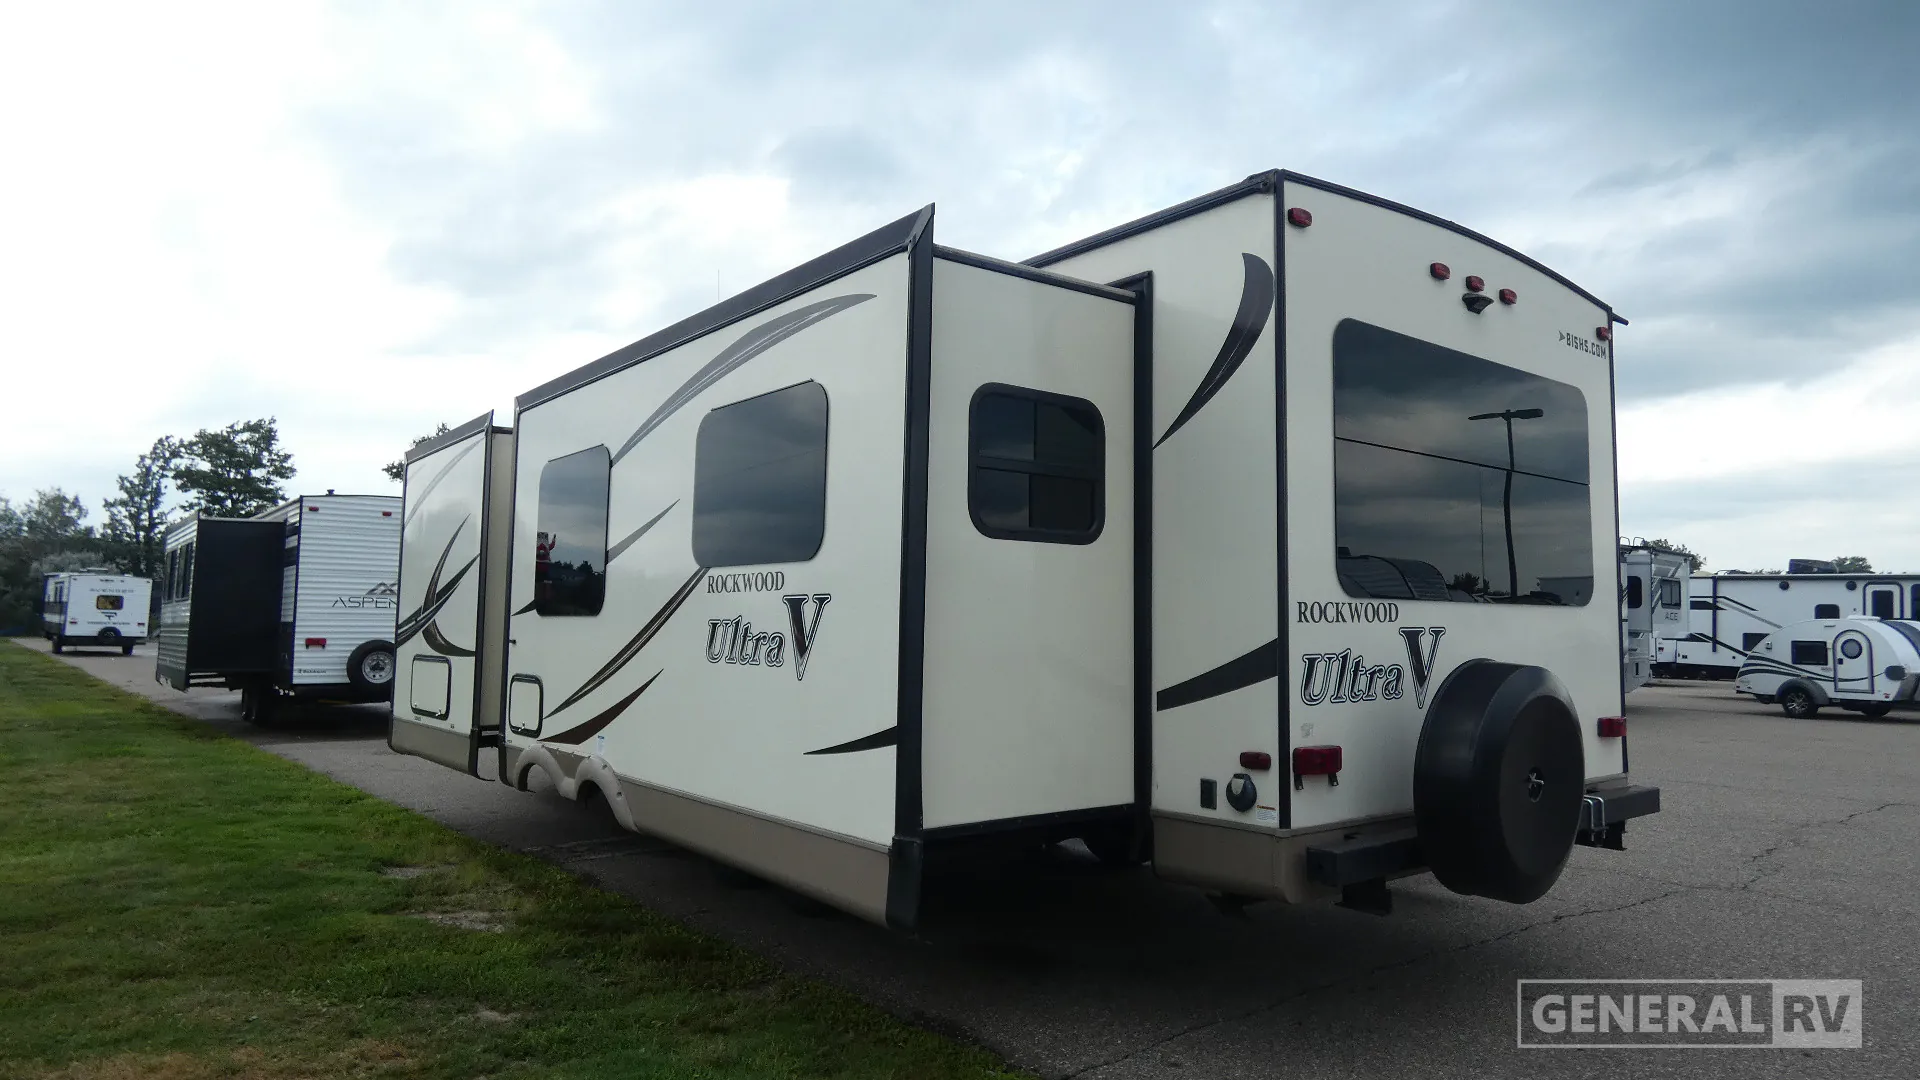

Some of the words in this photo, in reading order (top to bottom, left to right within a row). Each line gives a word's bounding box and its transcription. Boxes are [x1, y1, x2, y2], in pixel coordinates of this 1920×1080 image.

[1566, 332, 1607, 360] BISHS.COM
[707, 571, 785, 594] ROCKWOOD
[1297, 601, 1399, 624] ROCKWOOD
